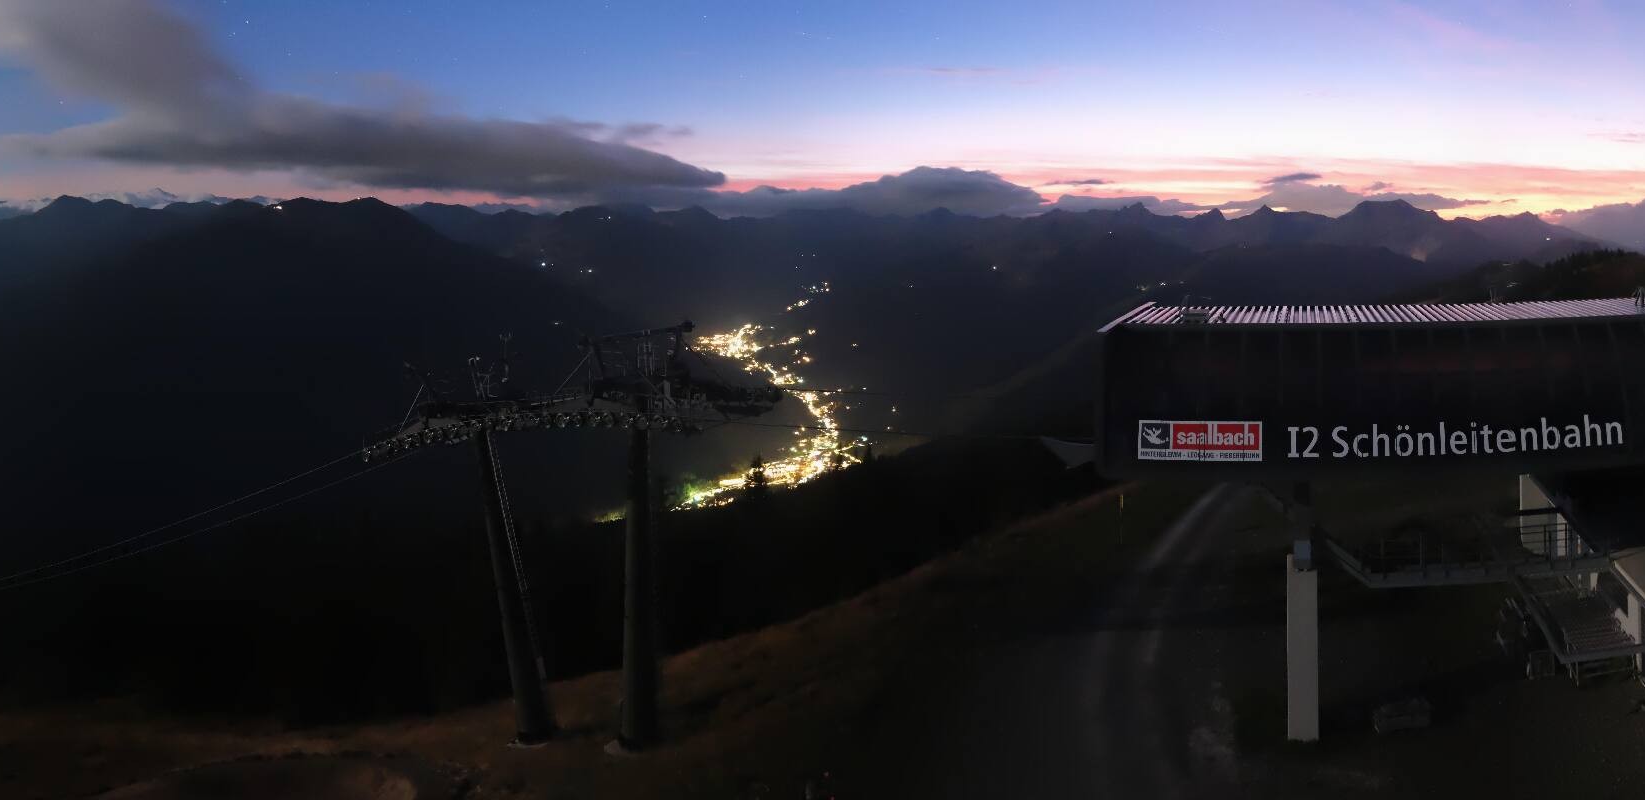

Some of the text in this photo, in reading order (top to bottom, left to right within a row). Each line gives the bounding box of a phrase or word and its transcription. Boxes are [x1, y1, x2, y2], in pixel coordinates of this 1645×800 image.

[1177, 423, 1255, 446] saalbach
[1287, 414, 1624, 458] I2 Schönleitenbahn
